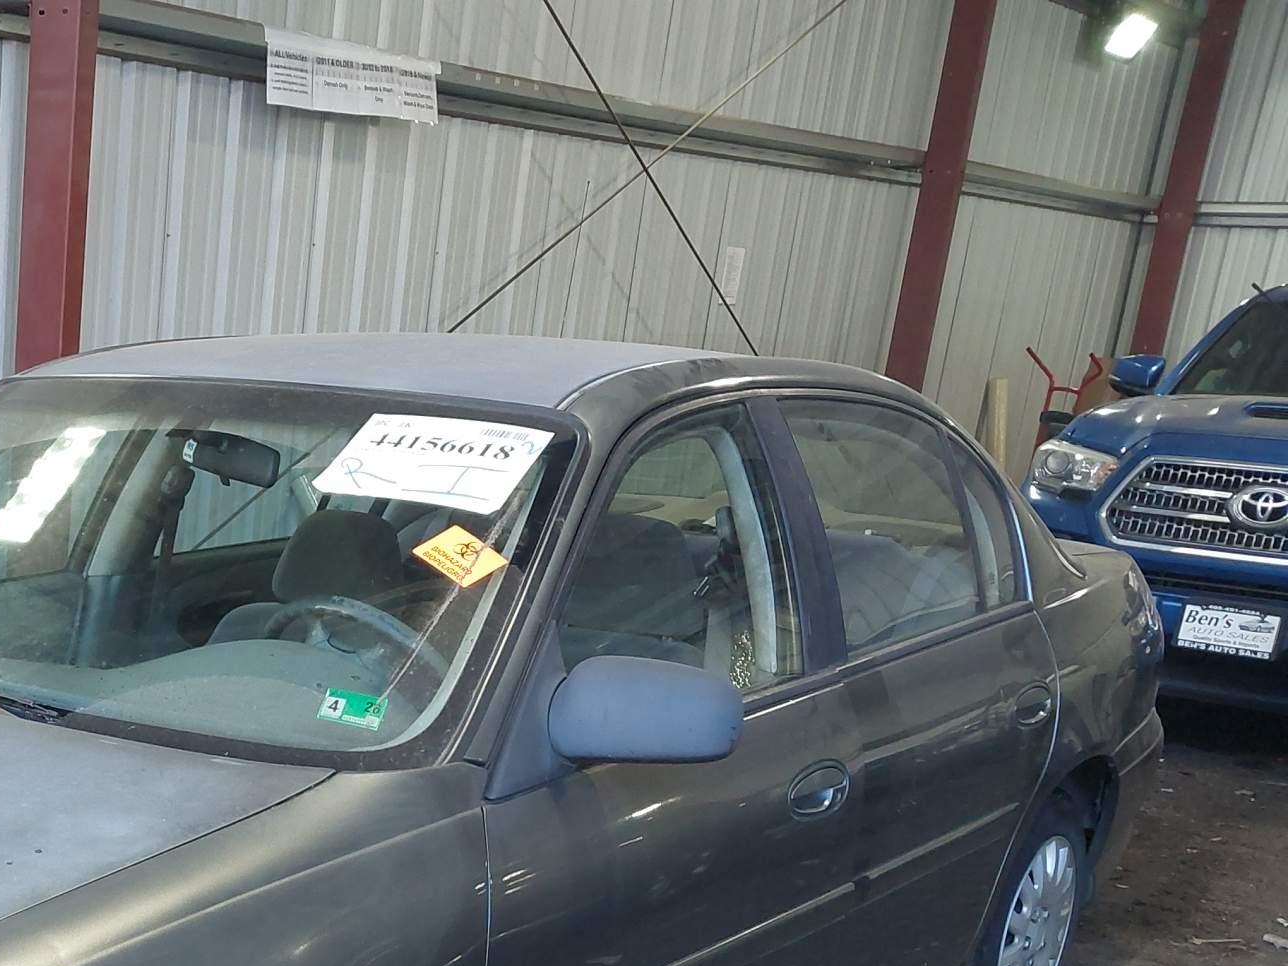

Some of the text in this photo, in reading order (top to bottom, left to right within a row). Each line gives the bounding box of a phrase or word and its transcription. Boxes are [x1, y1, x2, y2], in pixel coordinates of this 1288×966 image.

[370, 433, 515, 460] 44156618
[431, 545, 473, 575] BIOHAZARD
[1186, 610, 1233, 628] Ben's
[1188, 626, 1270, 643] AUTO SALES
[1178, 640, 1270, 659] BEN'S AUTO SALES
[328, 700, 339, 712] 4
[364, 702, 380, 714] 26
